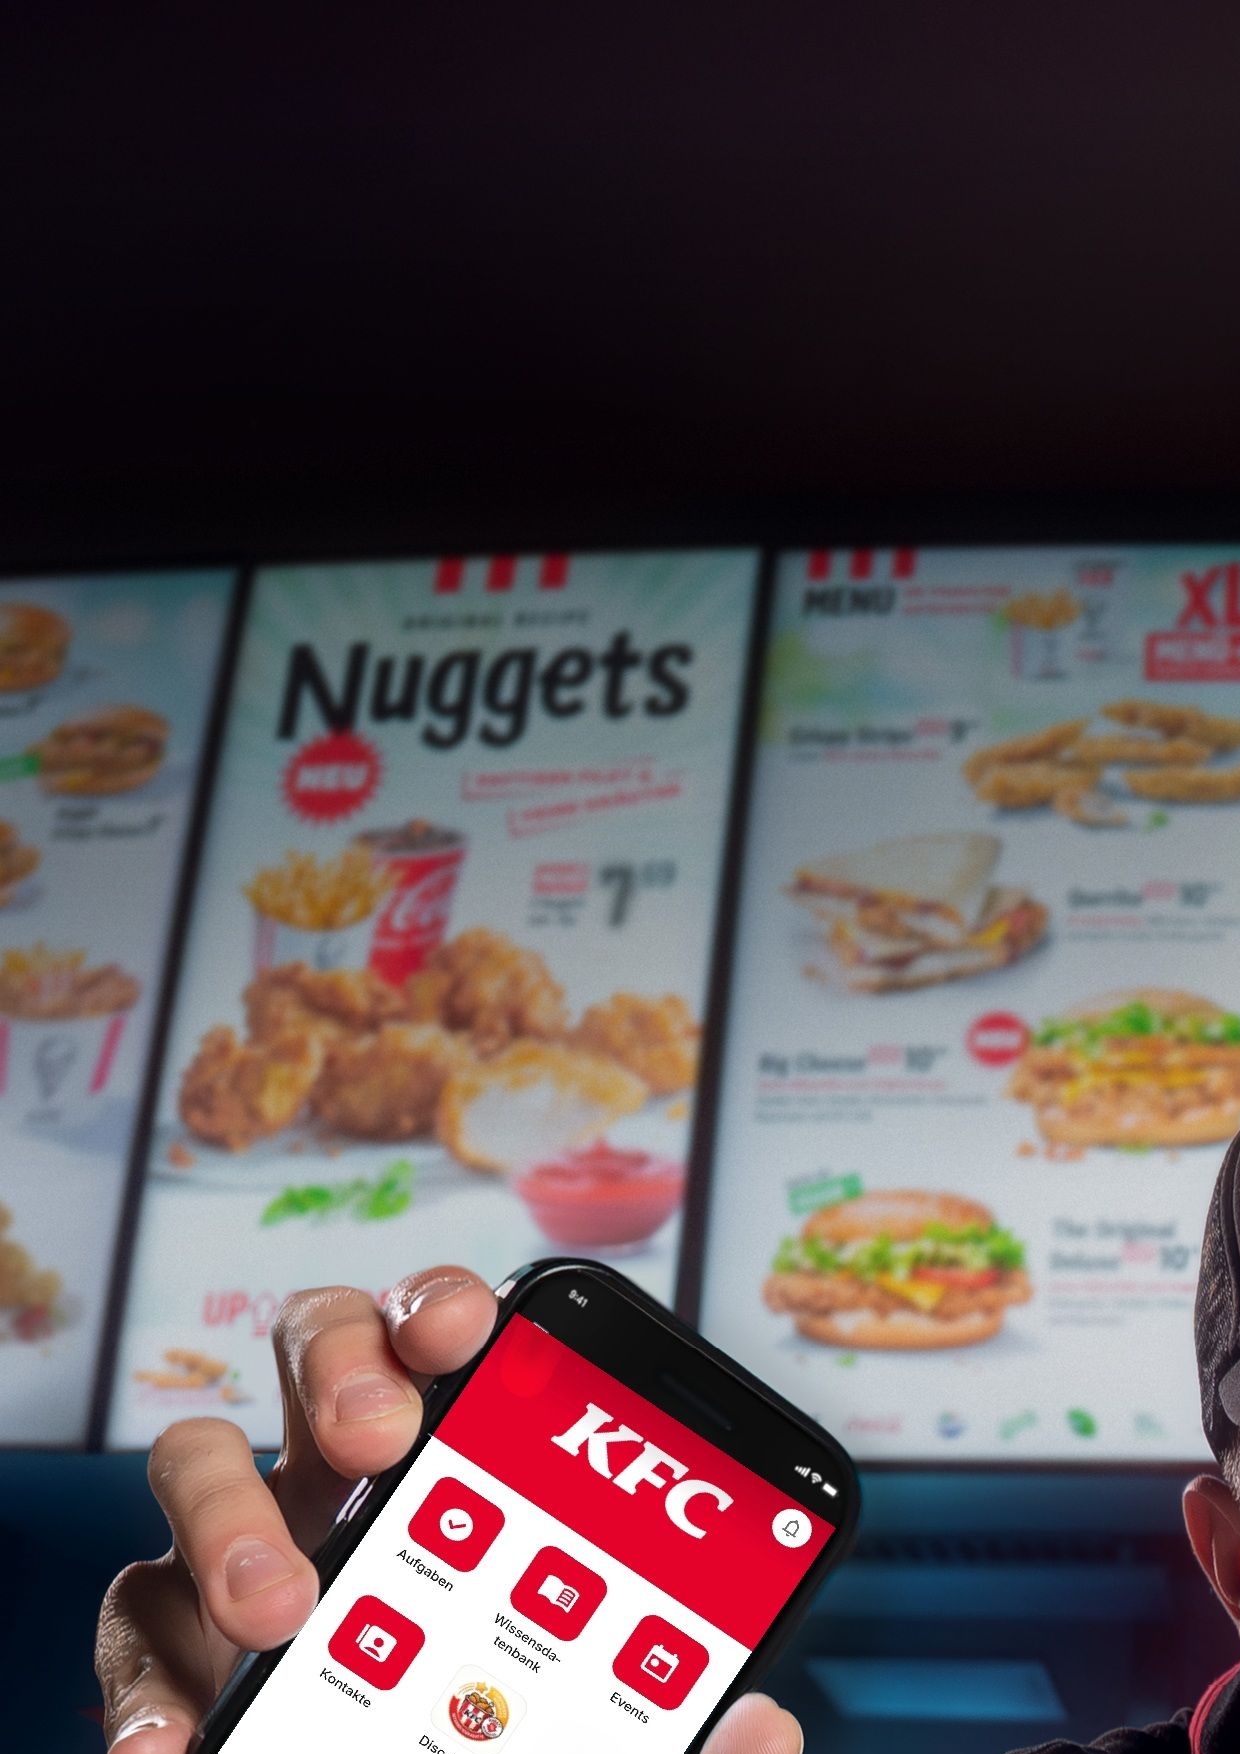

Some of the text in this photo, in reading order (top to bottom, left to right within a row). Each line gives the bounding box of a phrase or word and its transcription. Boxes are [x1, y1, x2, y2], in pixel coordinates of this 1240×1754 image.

[276, 630, 694, 750] Nuggets
[568, 1288, 589, 1308] 9:41
[550, 1402, 734, 1540] KFC
[396, 1548, 454, 1592] Aufgaben
[493, 1635, 542, 1674] tenbank
[494, 1612, 562, 1664] Wissensda-
[319, 1667, 372, 1709] Kontakte
[609, 1691, 651, 1725] Events
